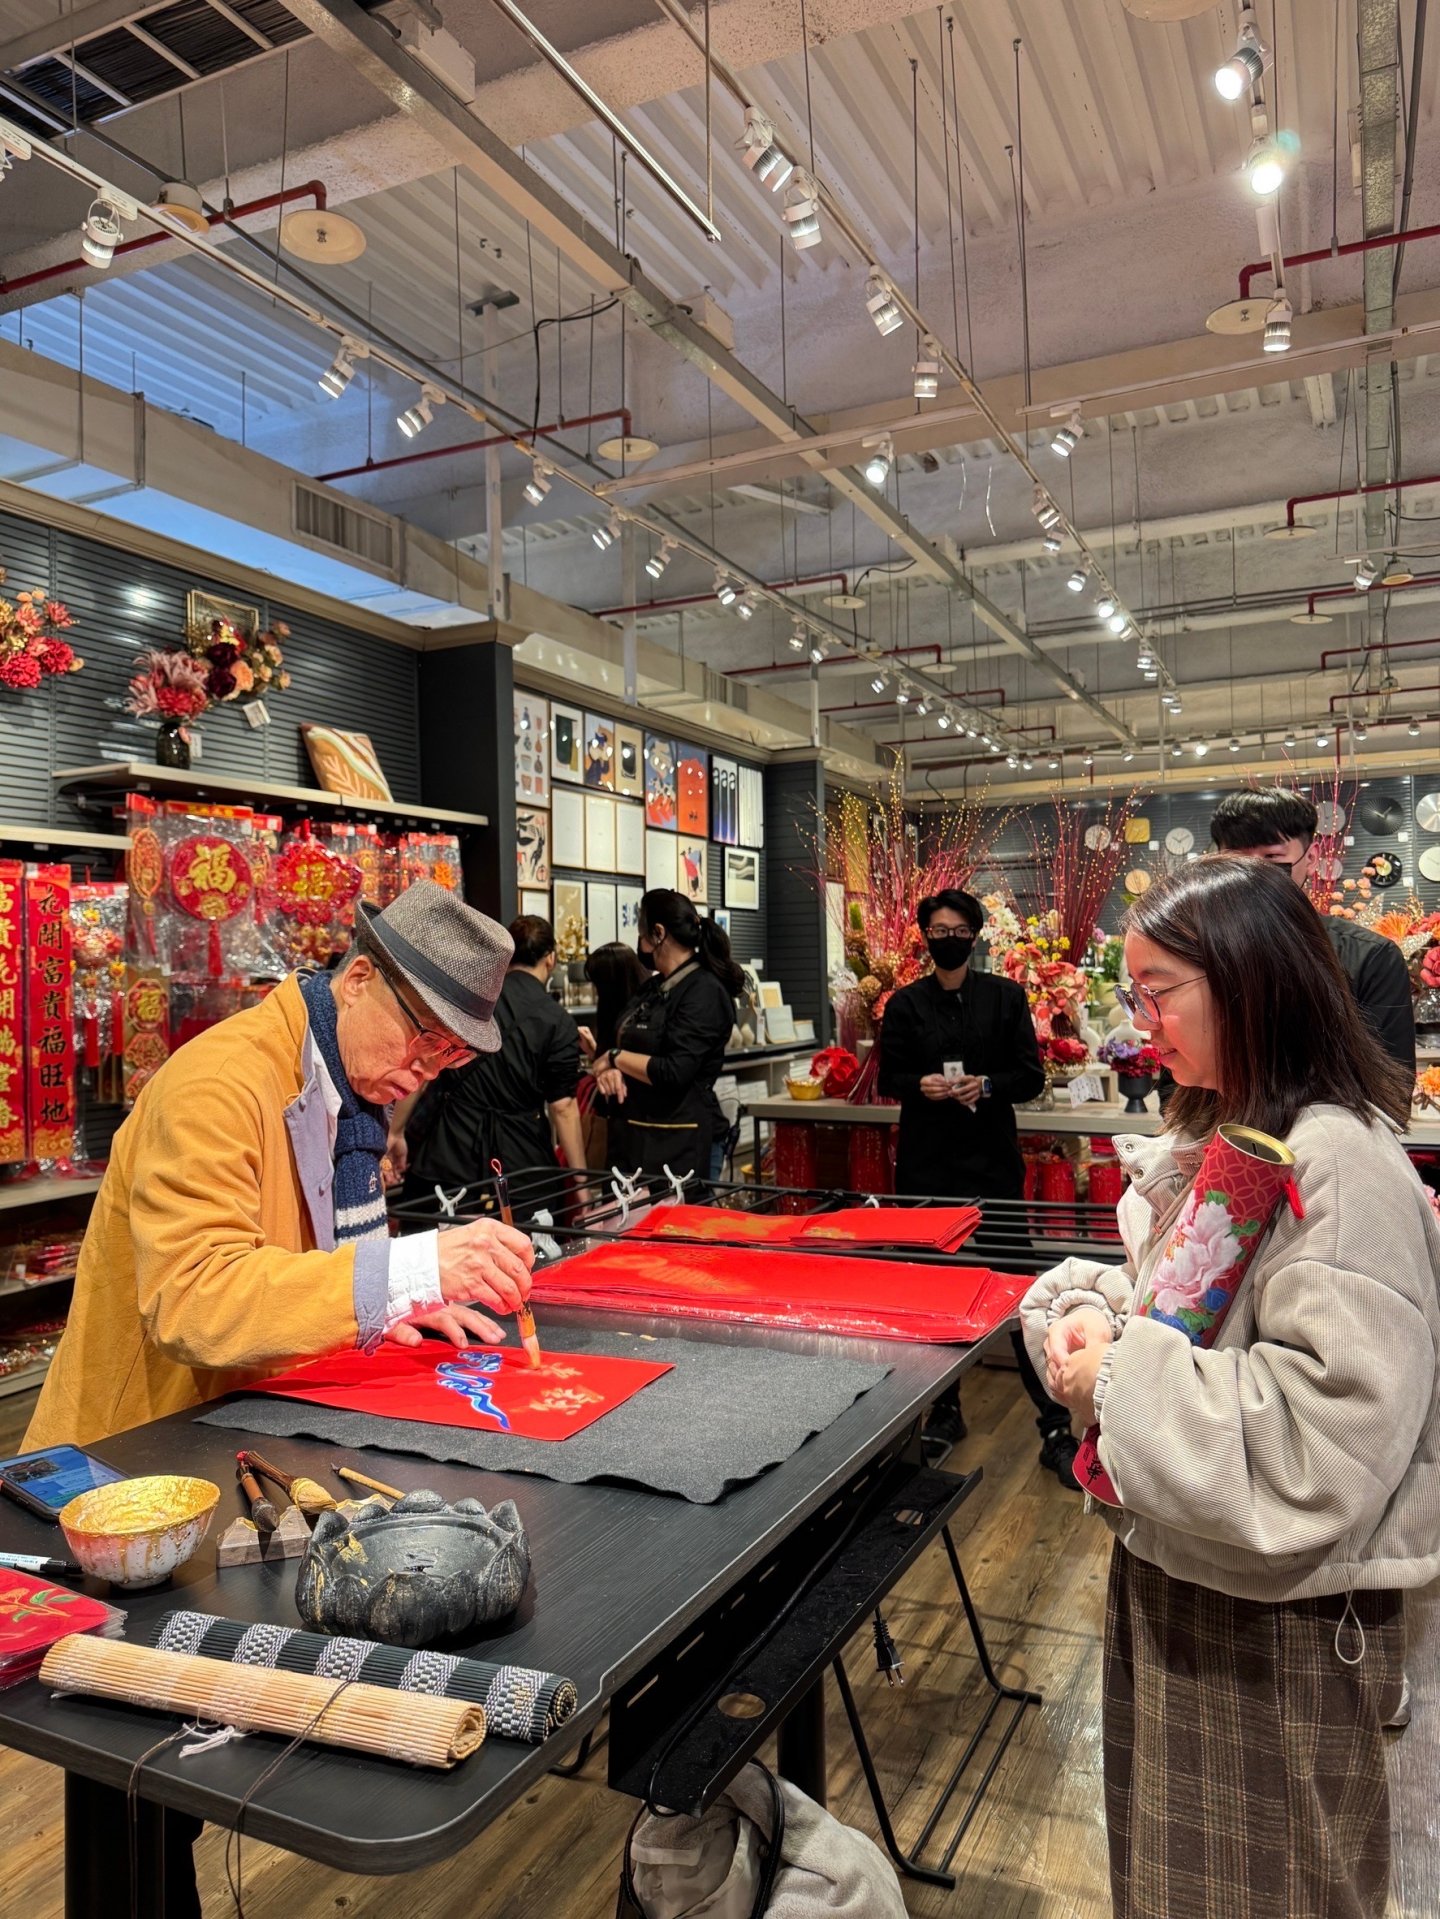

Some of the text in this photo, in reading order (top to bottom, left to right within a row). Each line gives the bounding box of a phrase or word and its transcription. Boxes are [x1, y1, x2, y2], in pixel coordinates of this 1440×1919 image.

[188, 843, 237, 893] 福
[38, 885, 69, 1125] 花開富貴福旺地
